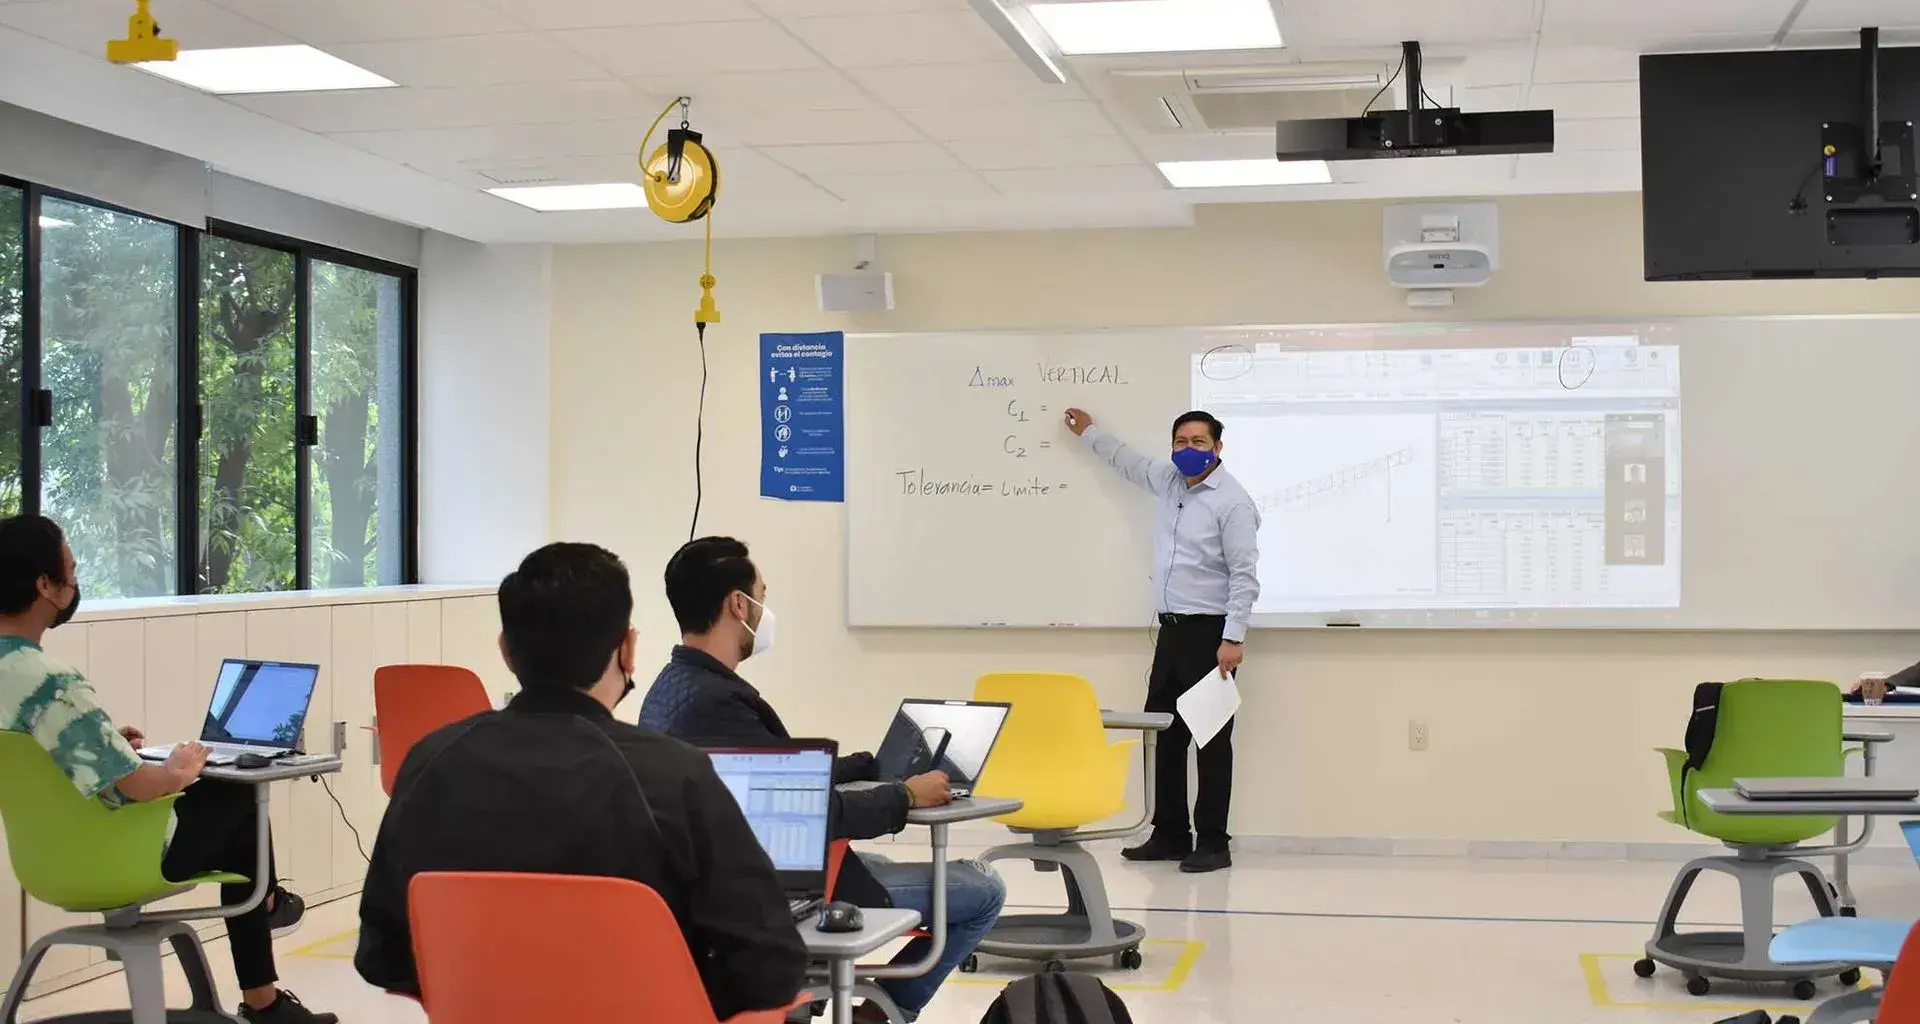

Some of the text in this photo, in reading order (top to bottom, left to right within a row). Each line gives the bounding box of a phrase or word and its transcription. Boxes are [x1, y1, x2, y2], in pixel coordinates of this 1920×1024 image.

[792, 343, 826, 351] distancia
[801, 350, 833, 359] contagio
[1037, 362, 1129, 385] VERTICAL
